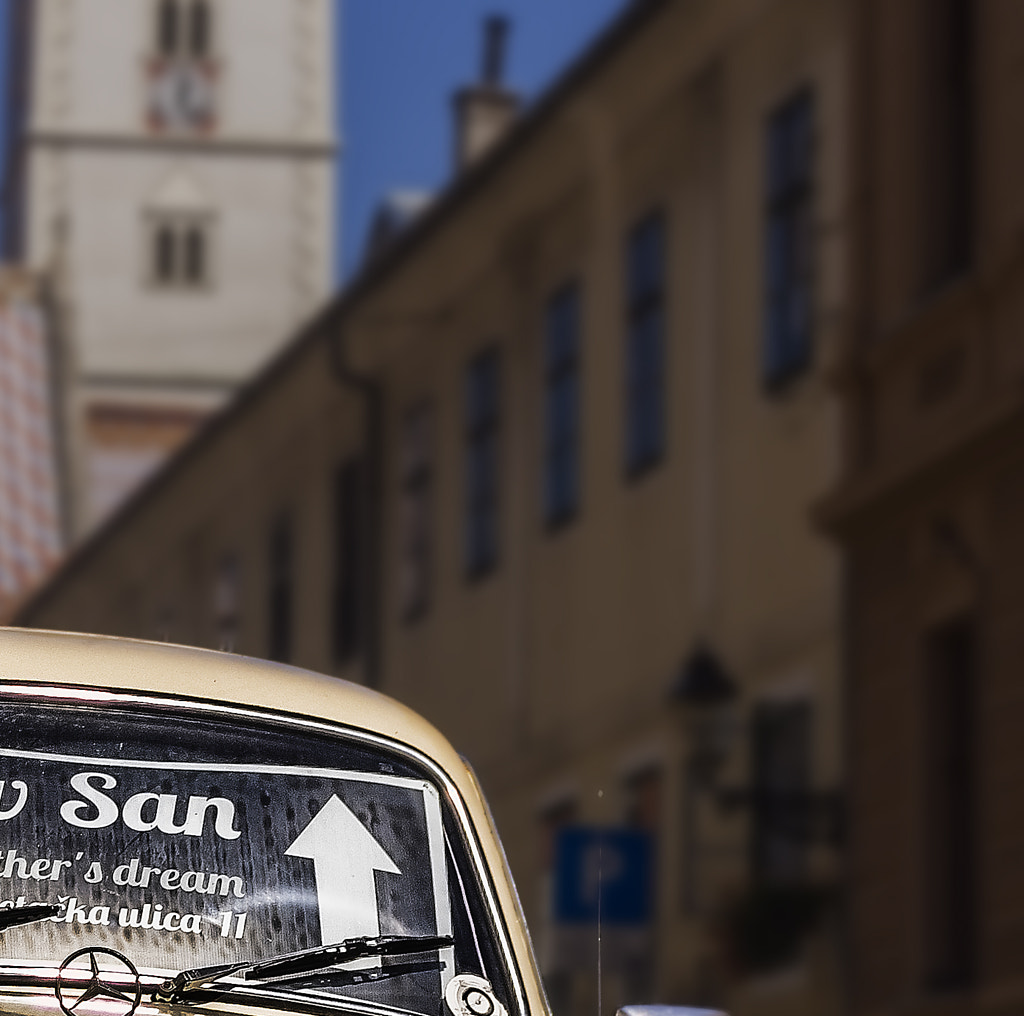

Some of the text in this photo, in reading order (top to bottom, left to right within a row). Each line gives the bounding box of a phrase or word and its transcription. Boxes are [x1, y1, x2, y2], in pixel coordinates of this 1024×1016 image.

[59, 772, 242, 841] San
[112, 858, 246, 898] dream
[119, 907, 202, 935] ulica
[219, 910, 248, 940] 11
